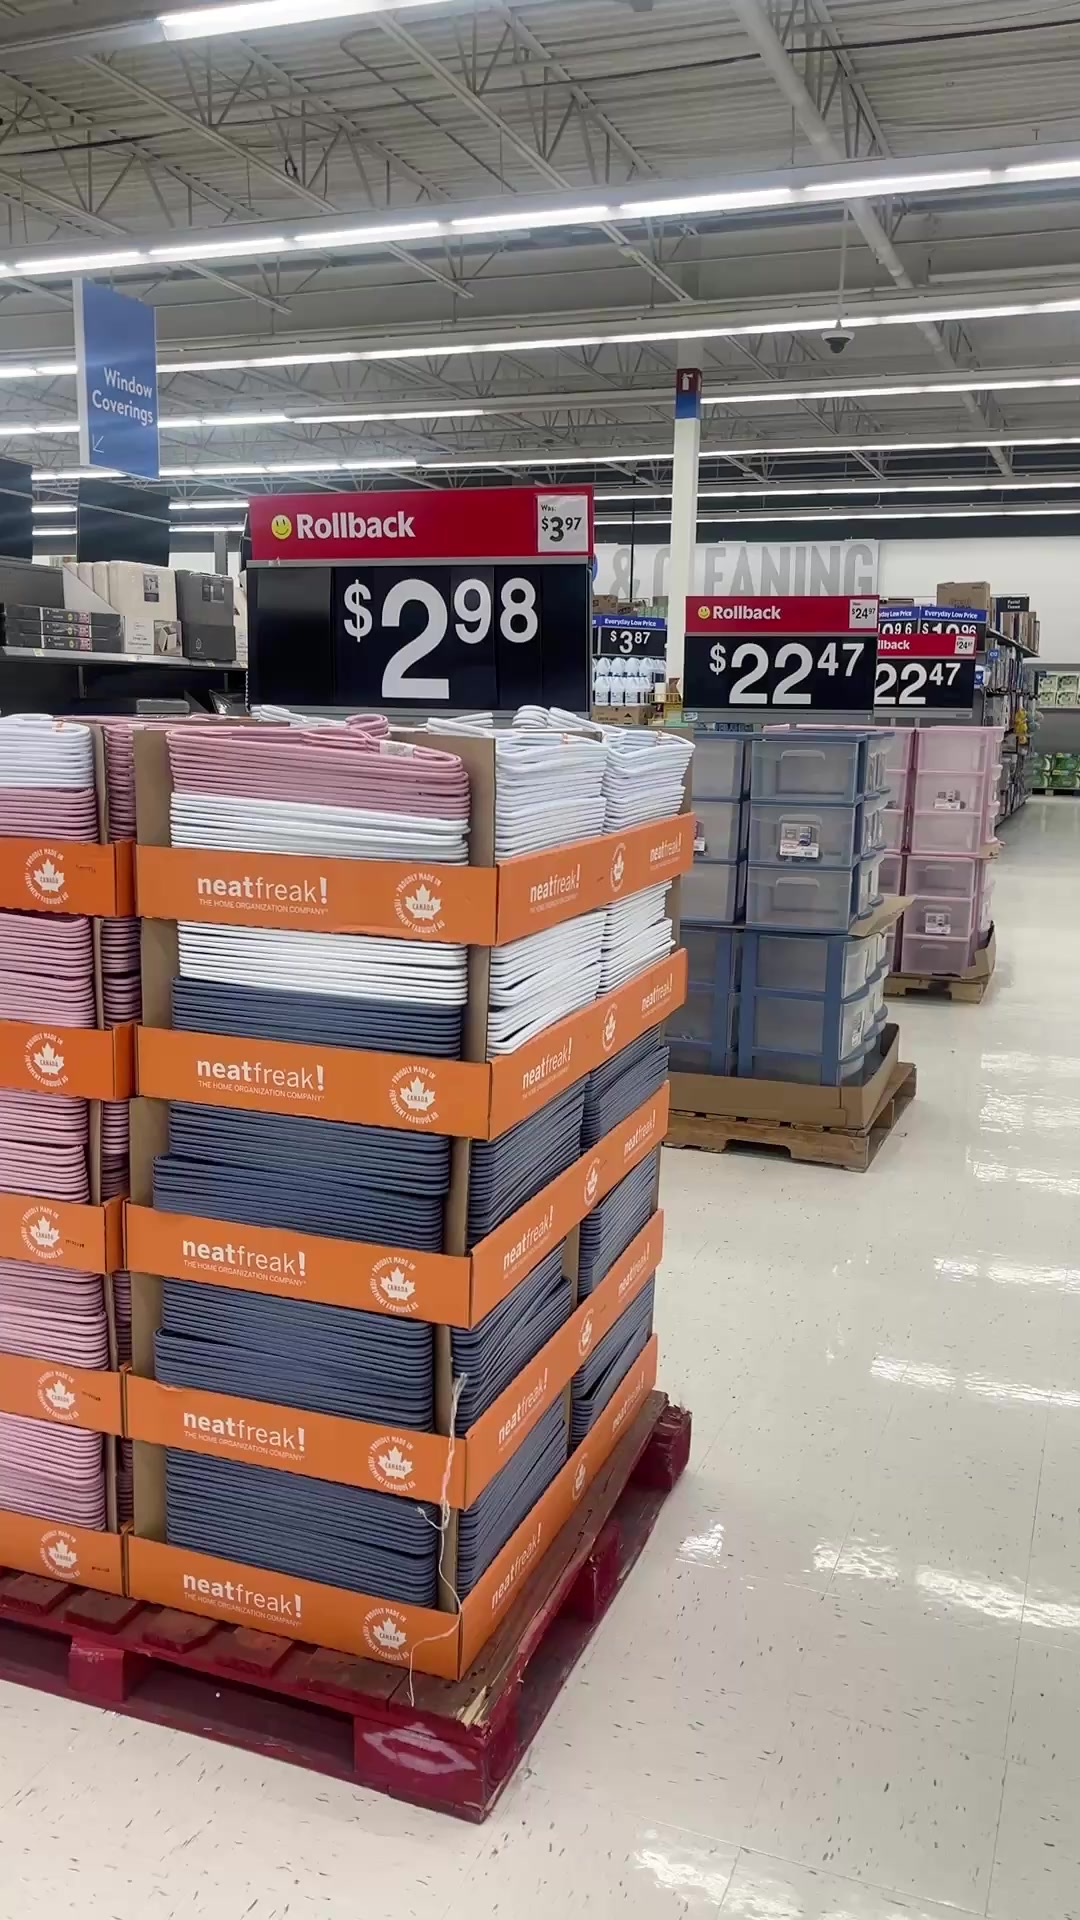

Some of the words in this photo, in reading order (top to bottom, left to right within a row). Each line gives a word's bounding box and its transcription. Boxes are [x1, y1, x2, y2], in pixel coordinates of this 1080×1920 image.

[103, 366, 153, 399] Window
[92, 389, 153, 427] Coverings
[296, 510, 416, 539] Rollback
[652, 543, 874, 597] CEANING
[604, 618, 630, 626] Everyday
[712, 605, 781, 621] Rollback
[924, 610, 950, 619] Everyday
[950, 611, 961, 619] Low
[961, 611, 978, 620] Price
[877, 640, 910, 650] llback
[874, 663, 961, 705] 2247
[418, 872, 434, 883] MADE
[197, 876, 327, 905] neatfreak!
[199, 898, 213, 907] THE
[213, 900, 235, 909] HOME
[236, 901, 289, 913] ORGANIZATION
[412, 903, 434, 911] CANADA
[197, 1060, 324, 1091] neatfreak!
[413, 1065, 429, 1076] MADE
[198, 1080, 211, 1089] THE
[213, 1081, 233, 1091] HOME
[234, 1084, 286, 1098] ORGANIZATION
[407, 1094, 428, 1103] CANADA
[182, 1239, 306, 1276] neatfreak!
[393, 1256, 408, 1267] MADE
[184, 1259, 196, 1269] THE
[197, 1262, 217, 1272] HOME
[218, 1265, 268, 1280] ORGANIZATION
[388, 1284, 408, 1292] CANADA
[183, 1412, 305, 1452] neatfreak!
[184, 1431, 196, 1439] THE
[198, 1434, 217, 1444] HOME
[218, 1437, 268, 1455] ORGANIZATION
[183, 1574, 302, 1618] neatfreak!
[184, 1592, 196, 1601] THE
[197, 1596, 217, 1606] HOME
[217, 1600, 266, 1619] ORGANIZATION
[380, 1633, 399, 1642] CANADA
